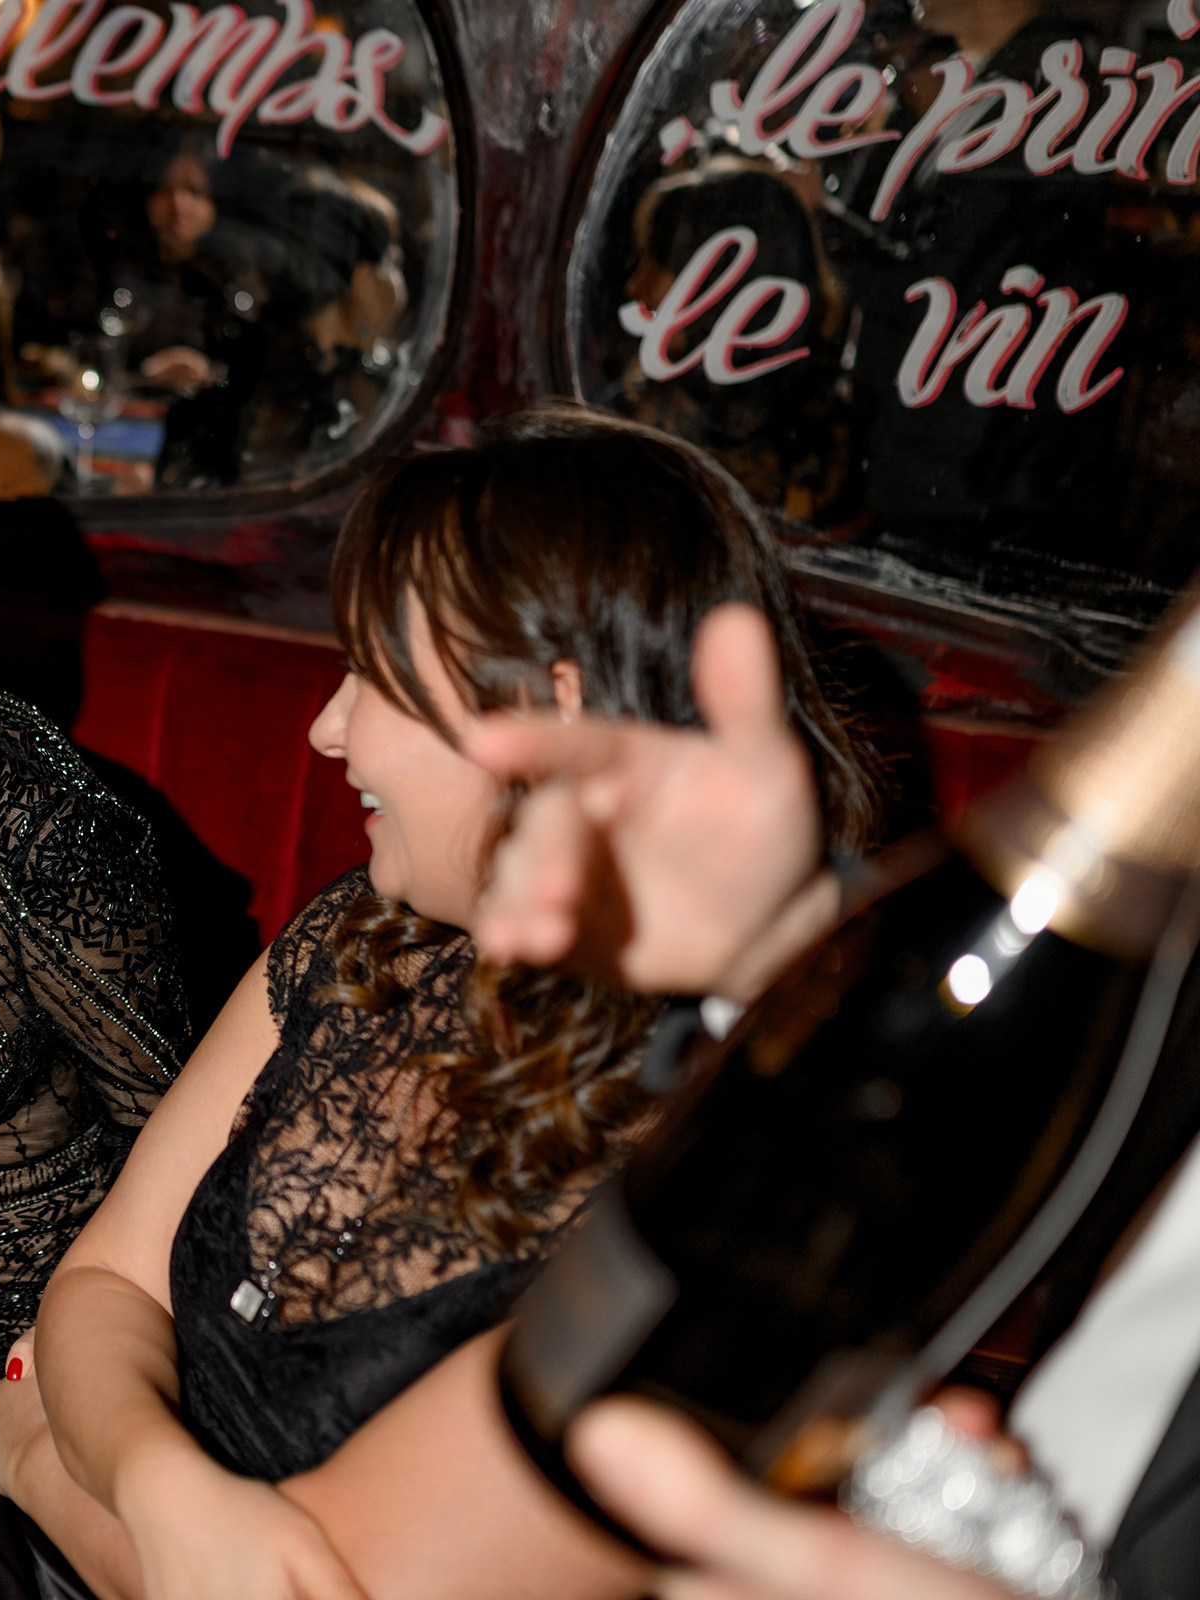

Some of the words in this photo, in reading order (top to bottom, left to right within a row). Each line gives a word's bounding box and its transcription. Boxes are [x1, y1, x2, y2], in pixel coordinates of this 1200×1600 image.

[710, 0, 901, 158] le
[619, 226, 810, 384] le
[899, 265, 1127, 414] vin
